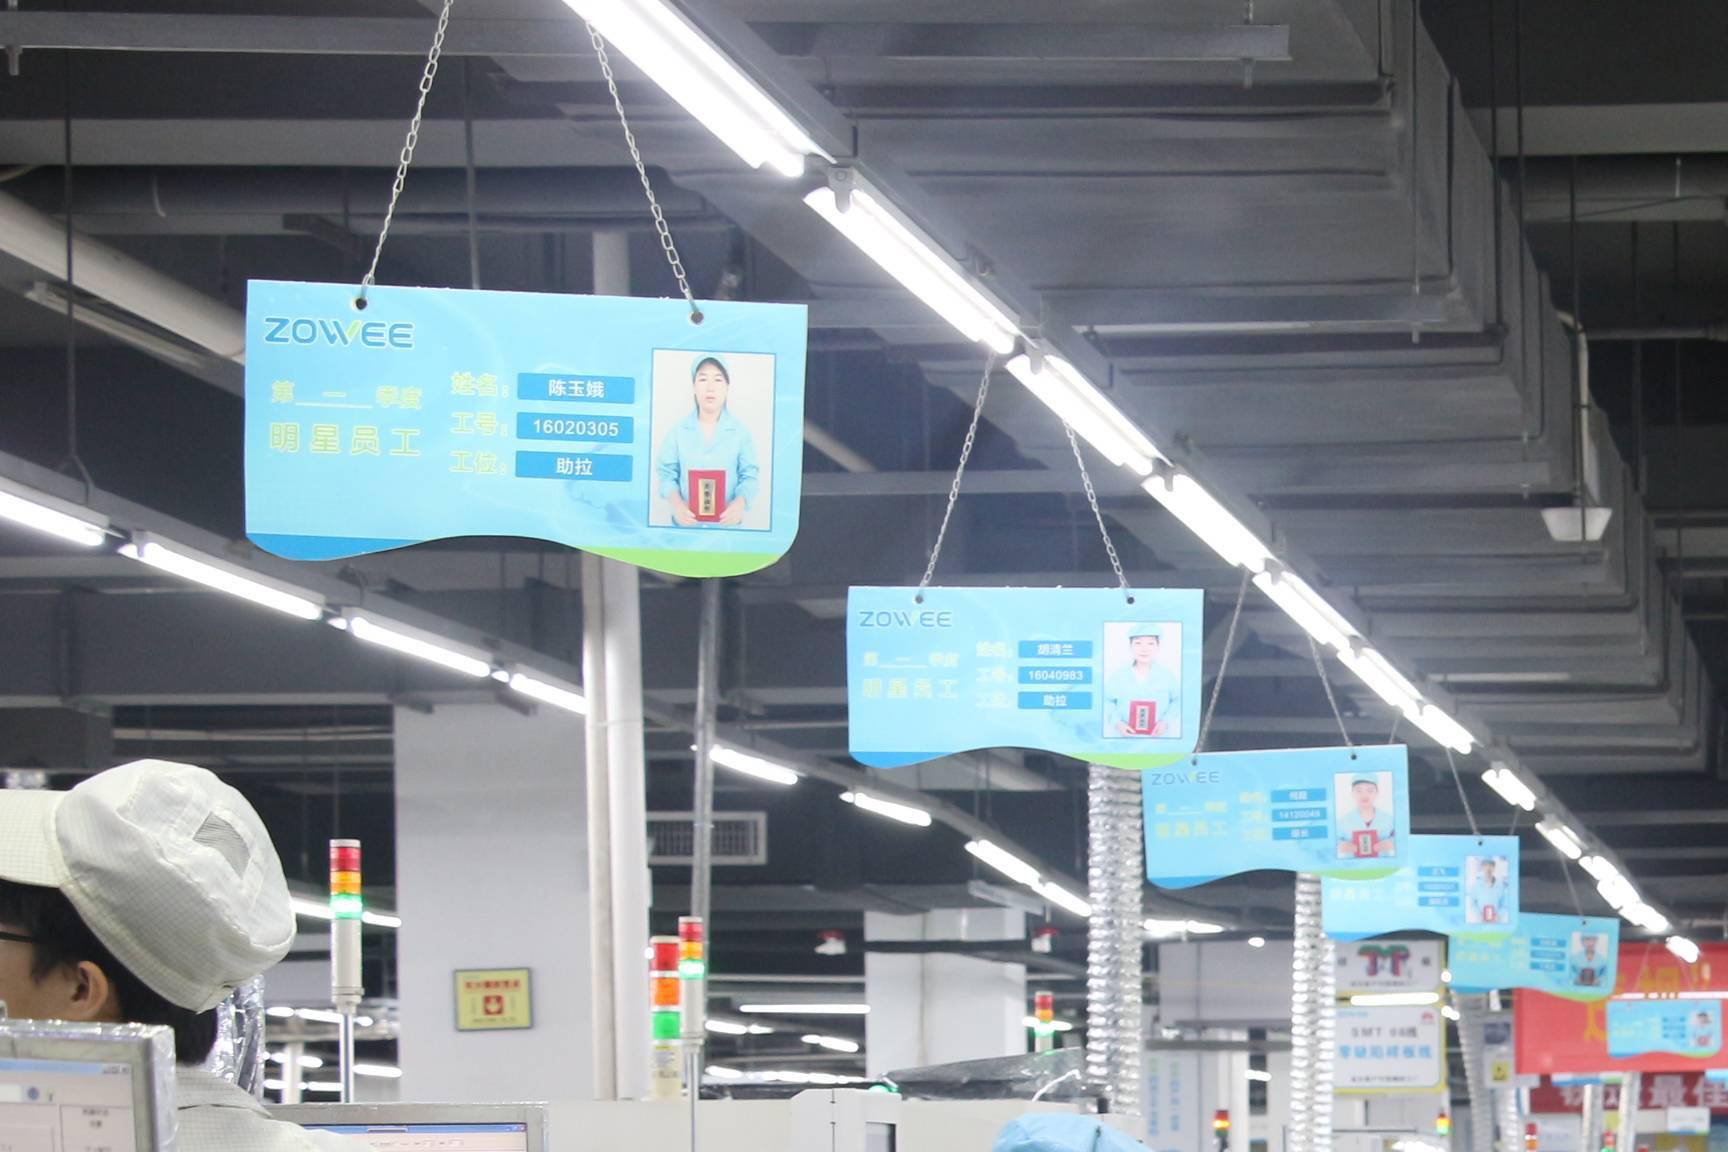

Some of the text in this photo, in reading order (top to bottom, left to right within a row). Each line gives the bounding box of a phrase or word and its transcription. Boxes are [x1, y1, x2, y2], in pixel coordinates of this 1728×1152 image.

[264, 317, 415, 349] ZOWEE
[533, 418, 620, 438] 16020305
[270, 422, 422, 456] 明星员工
[556, 457, 593, 477] 助拉
[859, 610, 952, 628] ZOWEE
[1028, 669, 1084, 682] 16040983
[1151, 771, 1220, 786] ZOWEE
